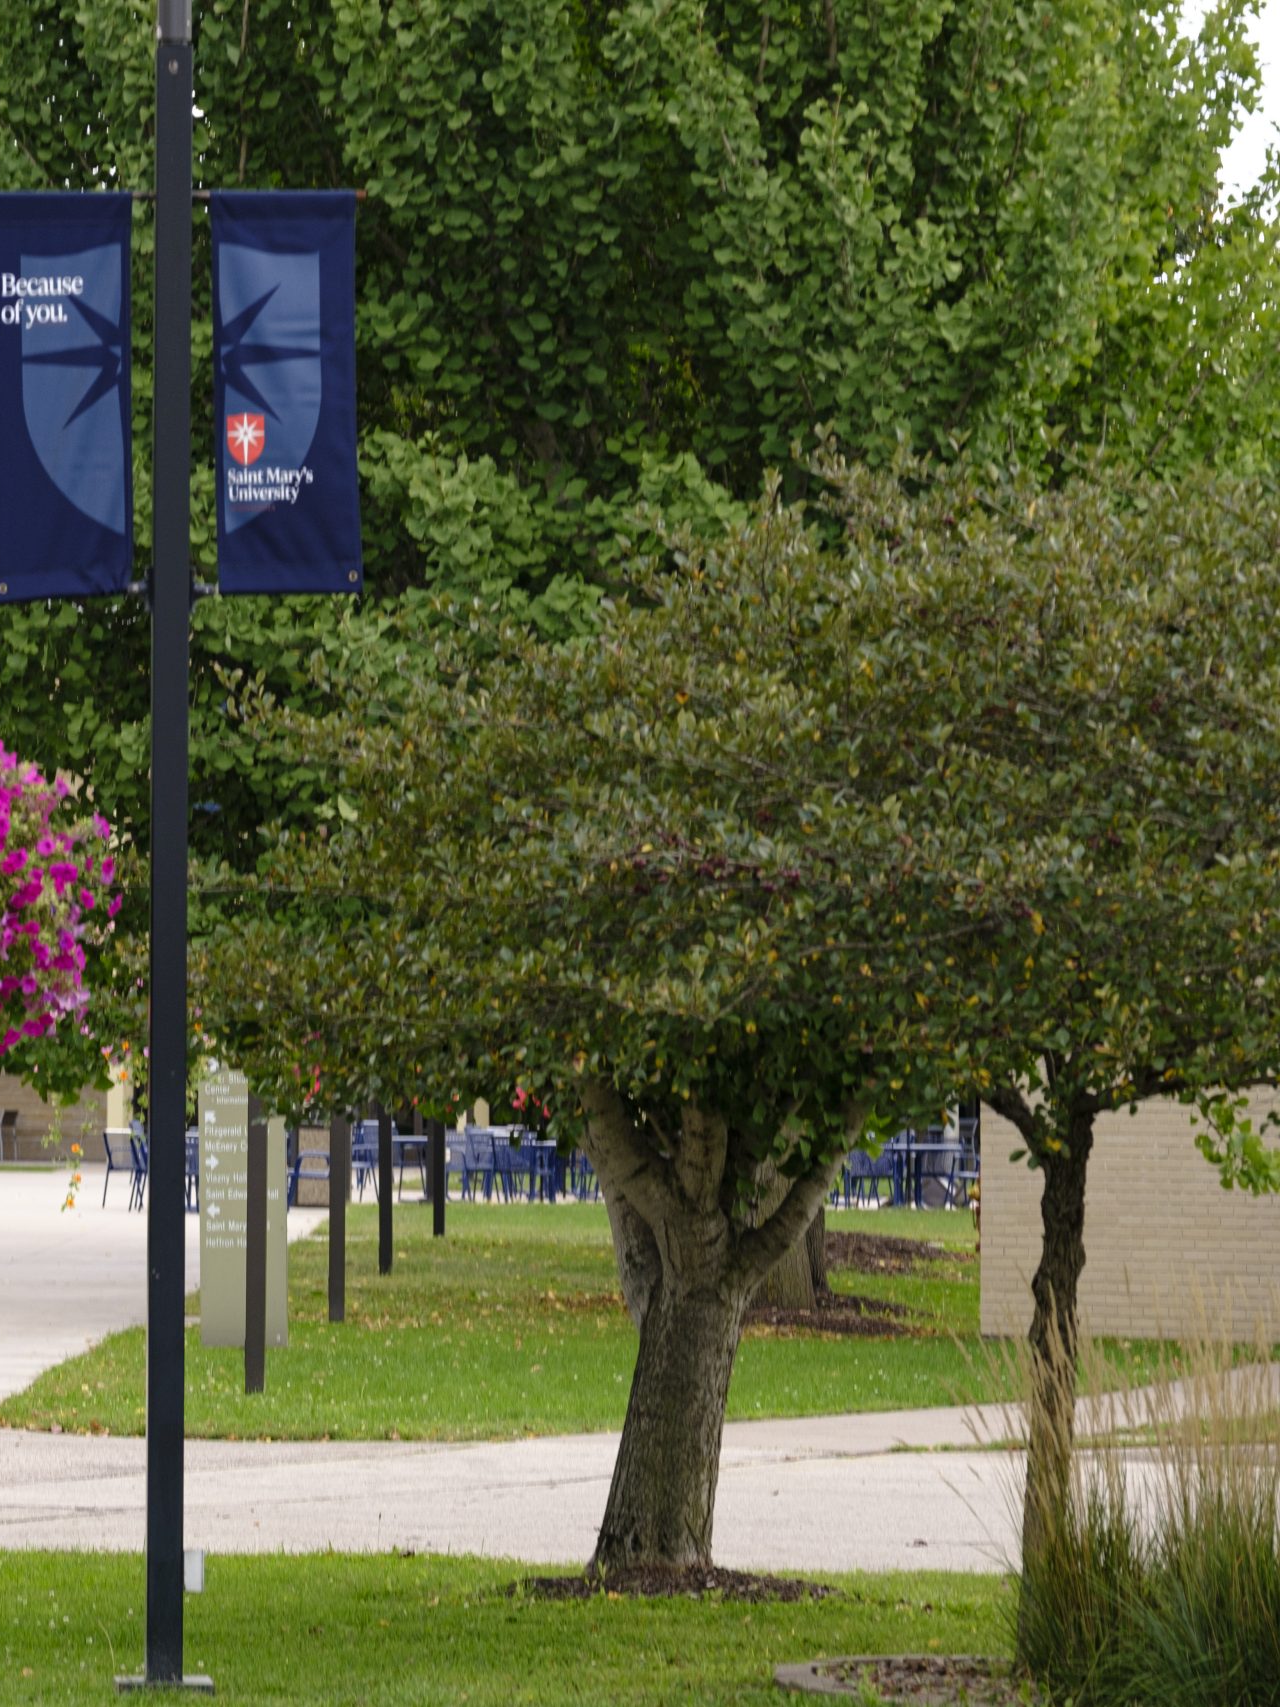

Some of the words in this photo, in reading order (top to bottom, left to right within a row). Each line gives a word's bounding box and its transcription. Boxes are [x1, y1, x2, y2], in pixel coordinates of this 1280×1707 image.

[1, 272, 84, 298] Because
[1, 298, 24, 325] of
[25, 303, 68, 330] you.
[227, 467, 265, 485] Saint
[266, 465, 314, 487] Mary's
[228, 484, 300, 505] University
[205, 1083, 230, 1095] Center
[204, 1125, 242, 1138] Fitzgerald
[204, 1141, 237, 1153] McEnery
[205, 1189, 225, 1200] Saint
[206, 1220, 225, 1231] Saint
